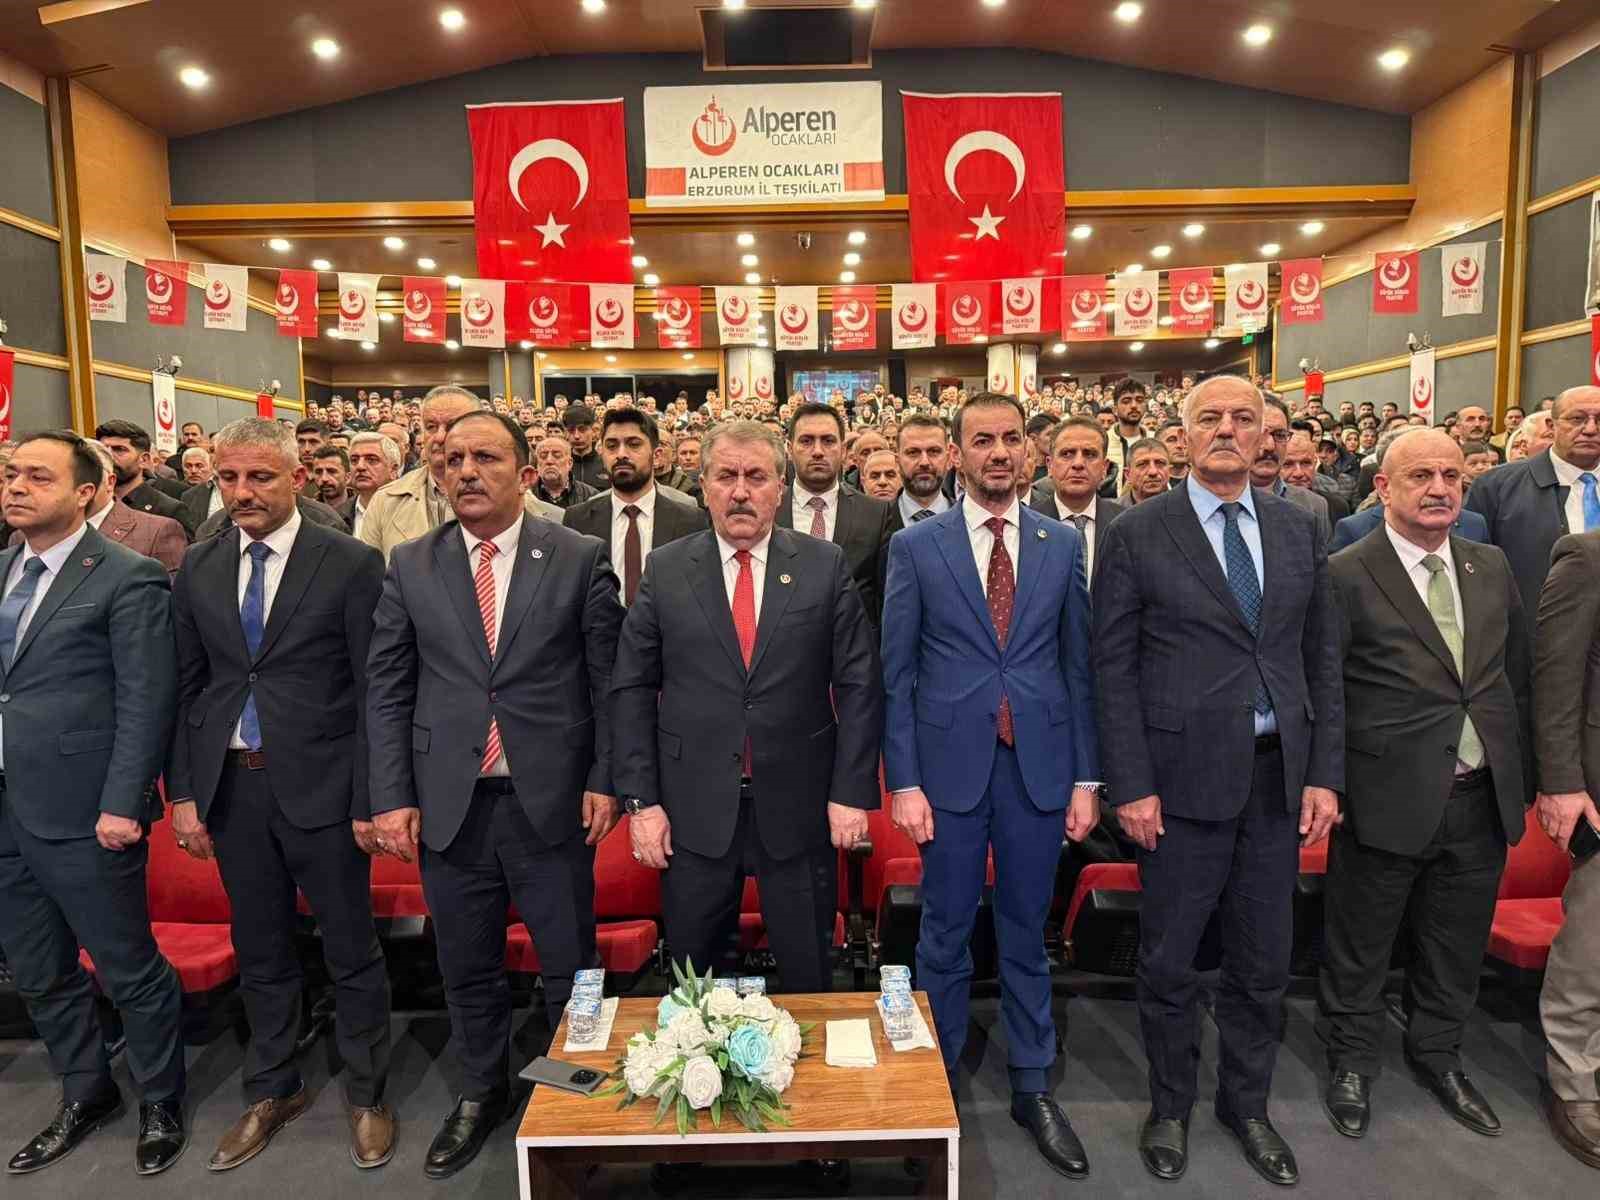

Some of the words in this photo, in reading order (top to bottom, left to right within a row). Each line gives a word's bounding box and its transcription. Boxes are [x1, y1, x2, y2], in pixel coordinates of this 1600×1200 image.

[742, 105, 836, 138] Alperen
[771, 133, 836, 146] OCAKLARI
[689, 165, 759, 180] ALPEREN
[763, 162, 839, 178] OCAKLARI
[688, 184, 755, 197] ERZURUM
[759, 181, 771, 195] İL
[776, 180, 841, 198] TEŞKİLATI
